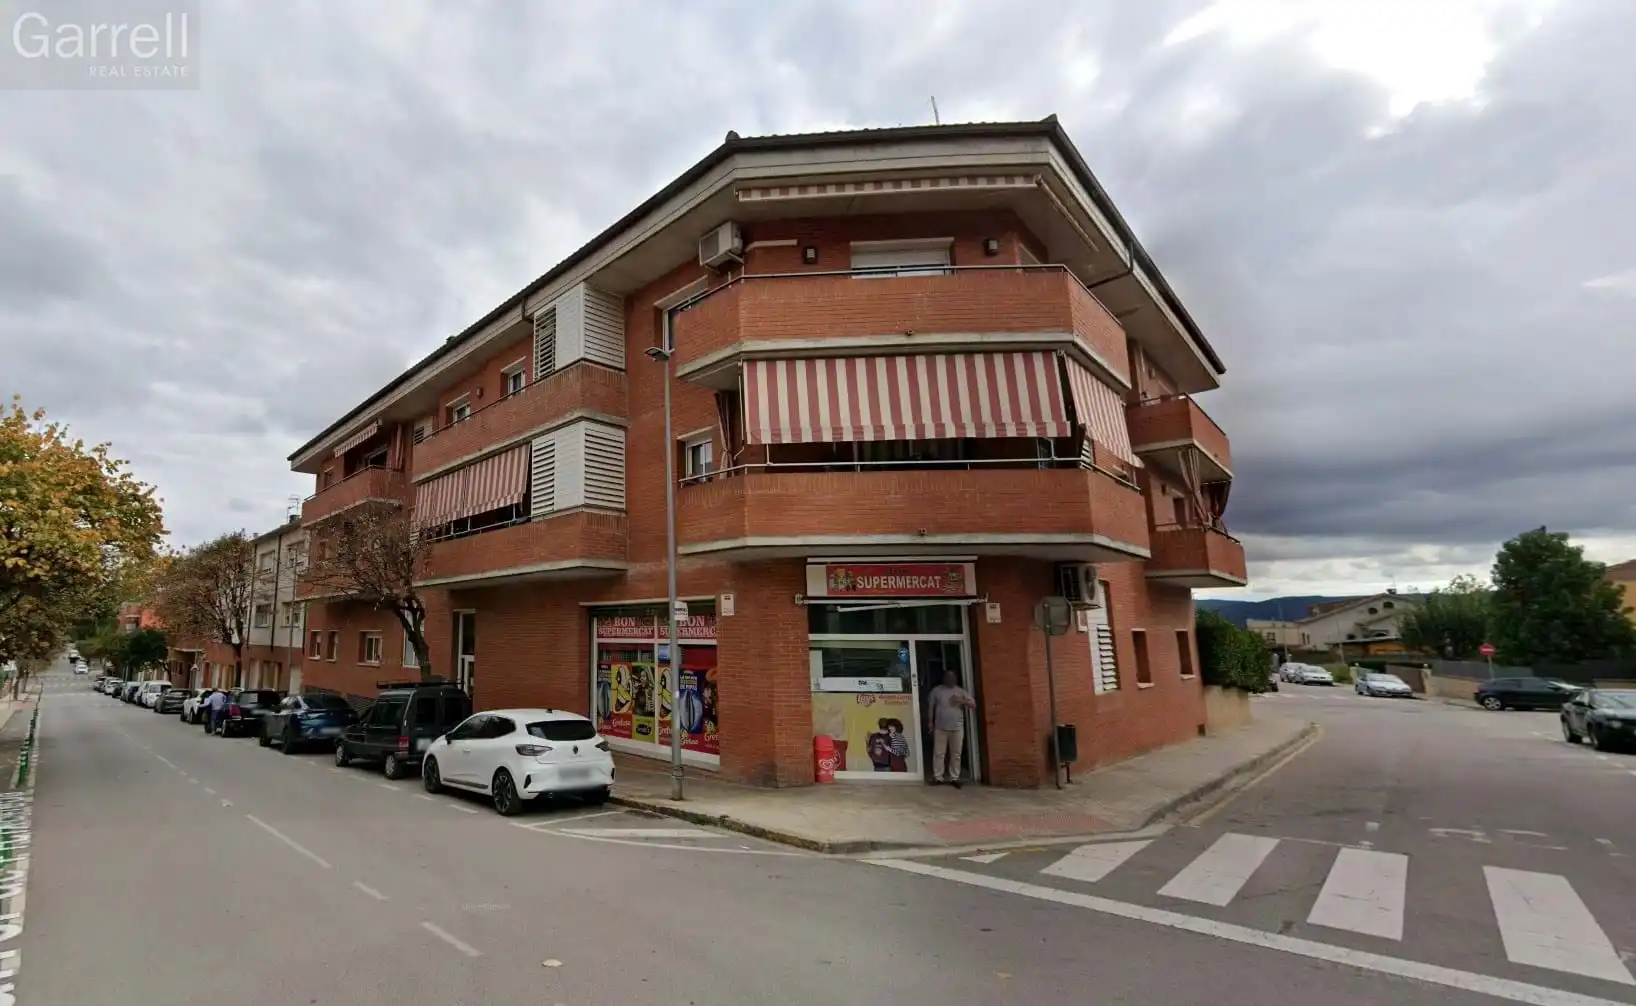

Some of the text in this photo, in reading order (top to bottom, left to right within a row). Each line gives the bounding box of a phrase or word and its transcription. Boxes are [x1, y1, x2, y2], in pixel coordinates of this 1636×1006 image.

[857, 575, 942, 589] SUPERMERCAT
[614, 616, 636, 627] BON
[598, 626, 653, 636] SUPERMERCAT
